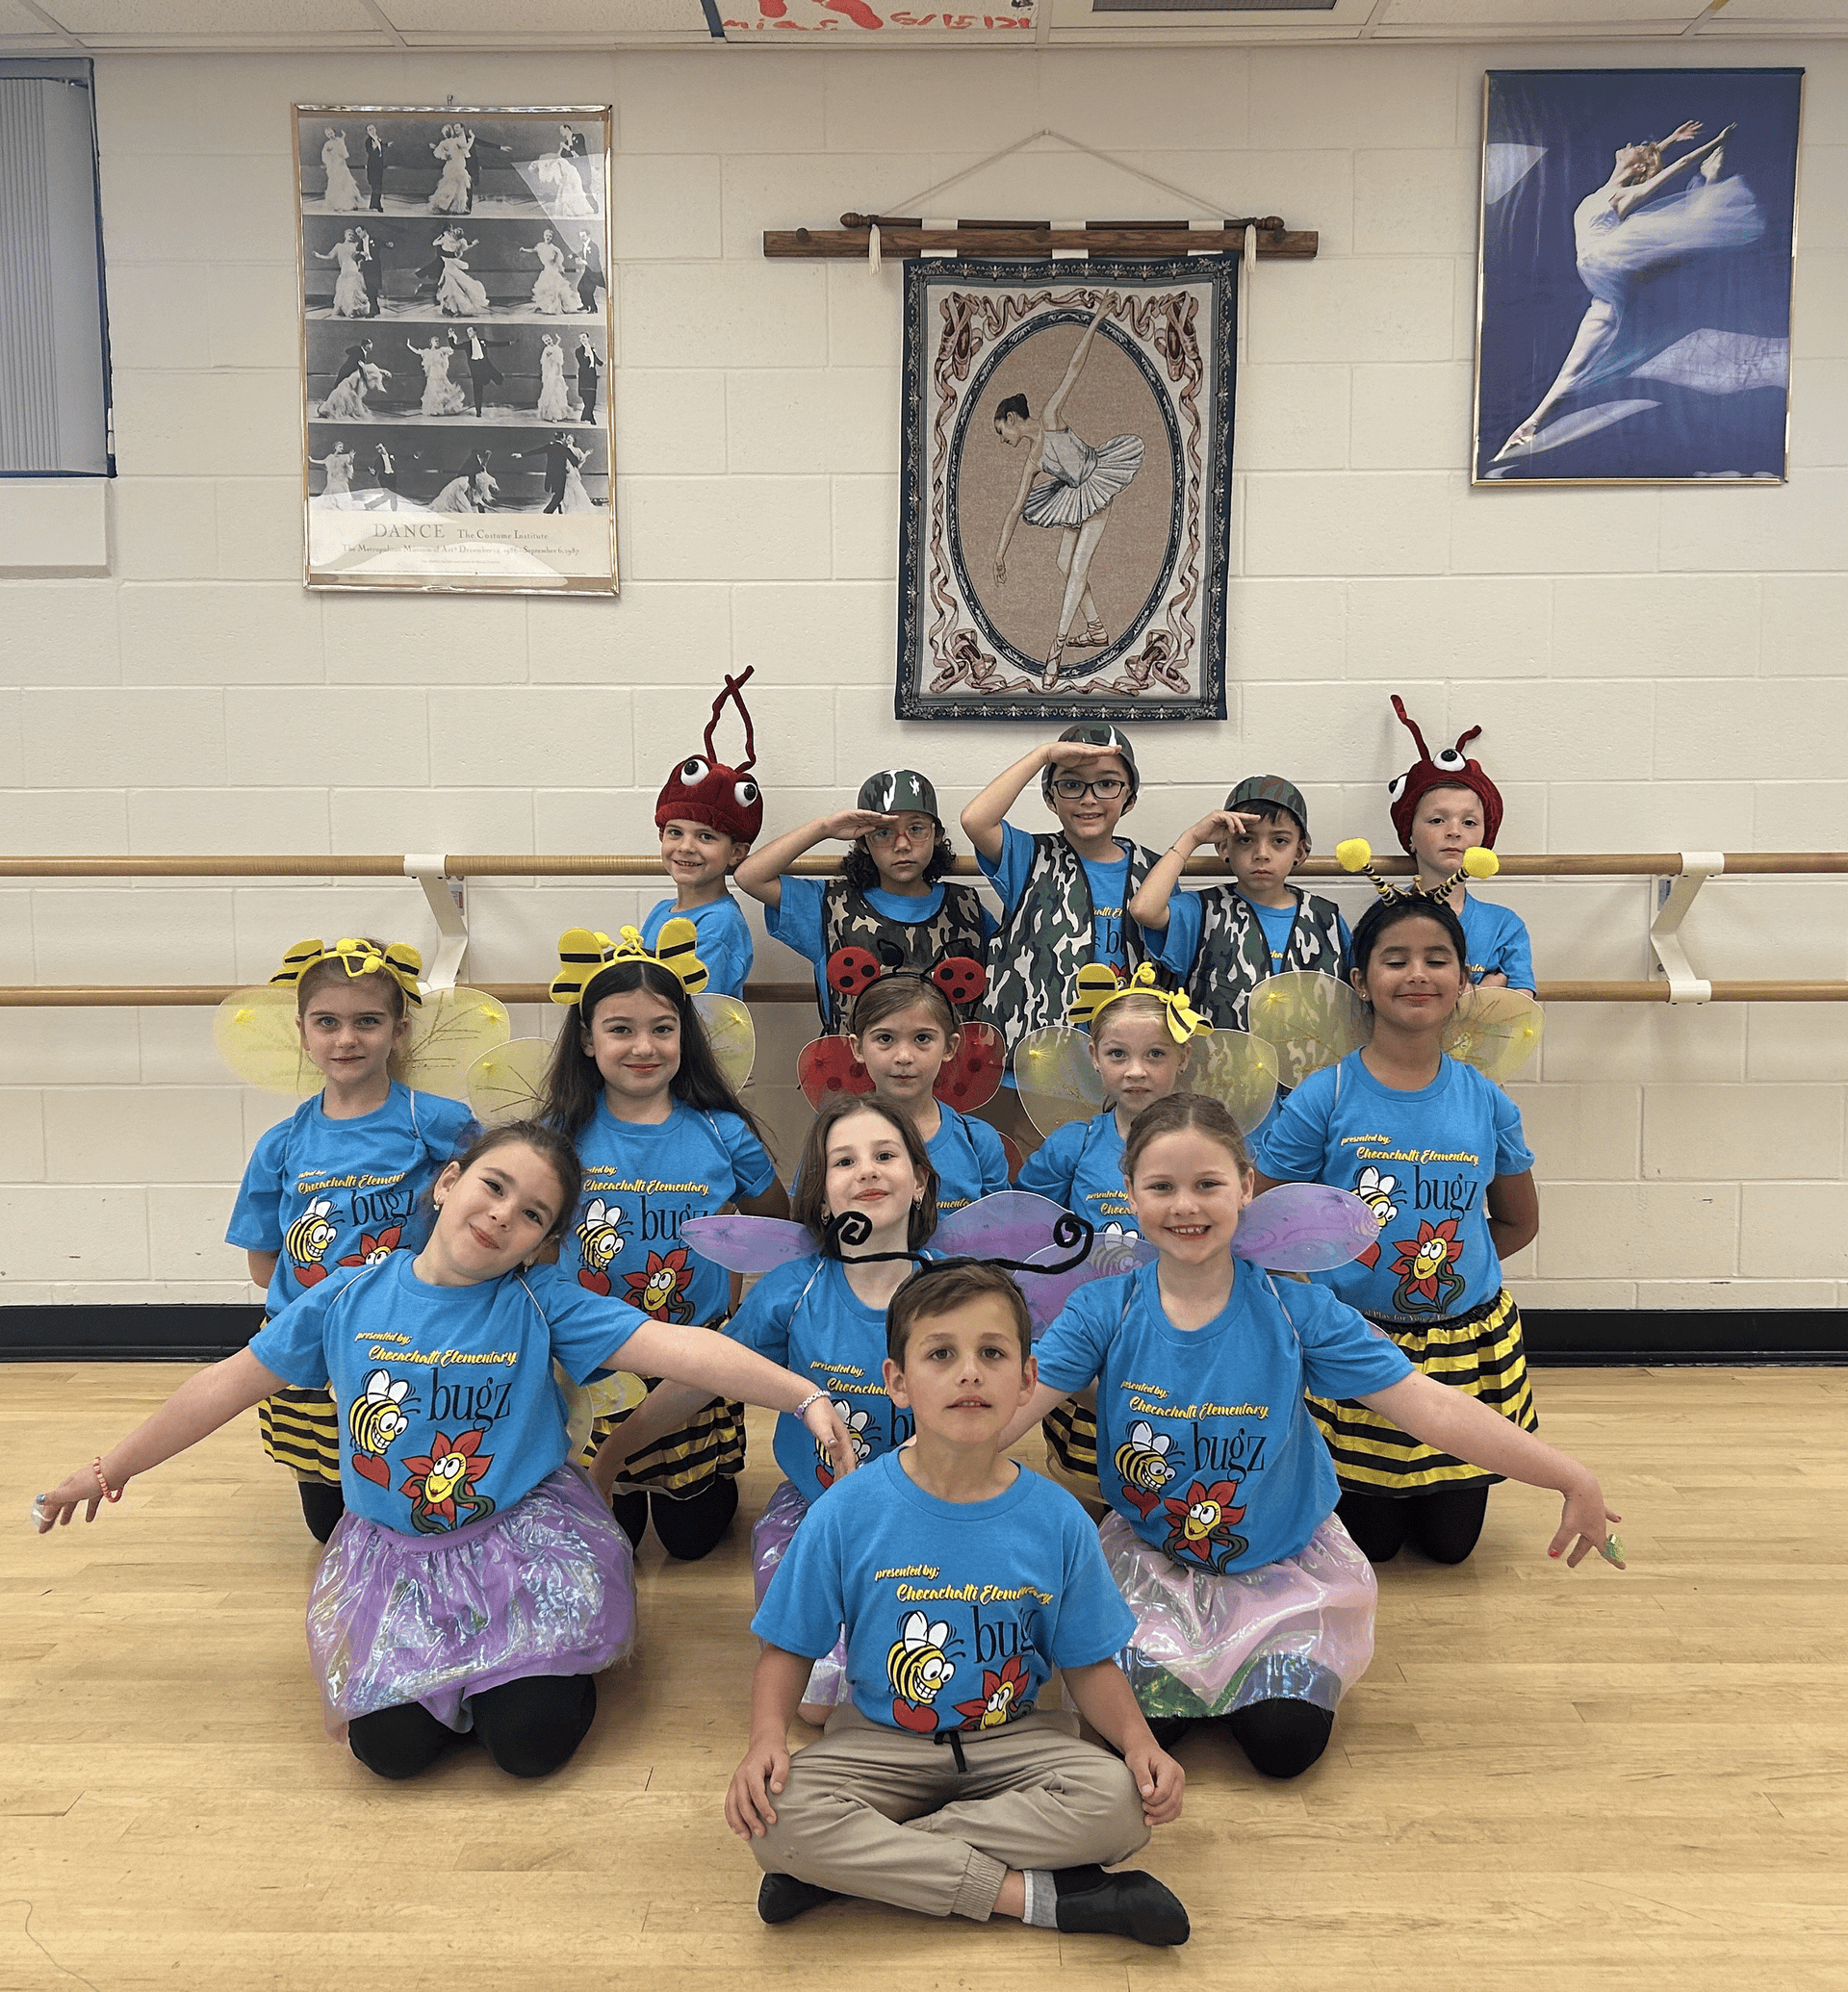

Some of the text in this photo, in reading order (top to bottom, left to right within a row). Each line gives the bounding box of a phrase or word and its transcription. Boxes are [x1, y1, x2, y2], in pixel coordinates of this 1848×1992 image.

[372, 524, 549, 541] DANCE The Costume Institute
[1341, 1134, 1377, 1146] presented
[1356, 1146, 1479, 1167] Chocachatti Elementary
[358, 1172, 407, 1189] Element
[646, 1179, 709, 1196] Elementary
[1413, 1164, 1478, 1222] bugz
[349, 1189, 418, 1229] bugz
[353, 1331, 397, 1343] presented
[368, 1344, 518, 1367] Chocachatti Elementary
[809, 1361, 852, 1375] presented
[426, 1366, 513, 1434] bugz
[1129, 1395, 1270, 1421] Chocachatti Elementary
[1190, 1421, 1267, 1483] bugz
[874, 1564, 921, 1581] presented
[896, 1582, 979, 1602] Chocachatti
